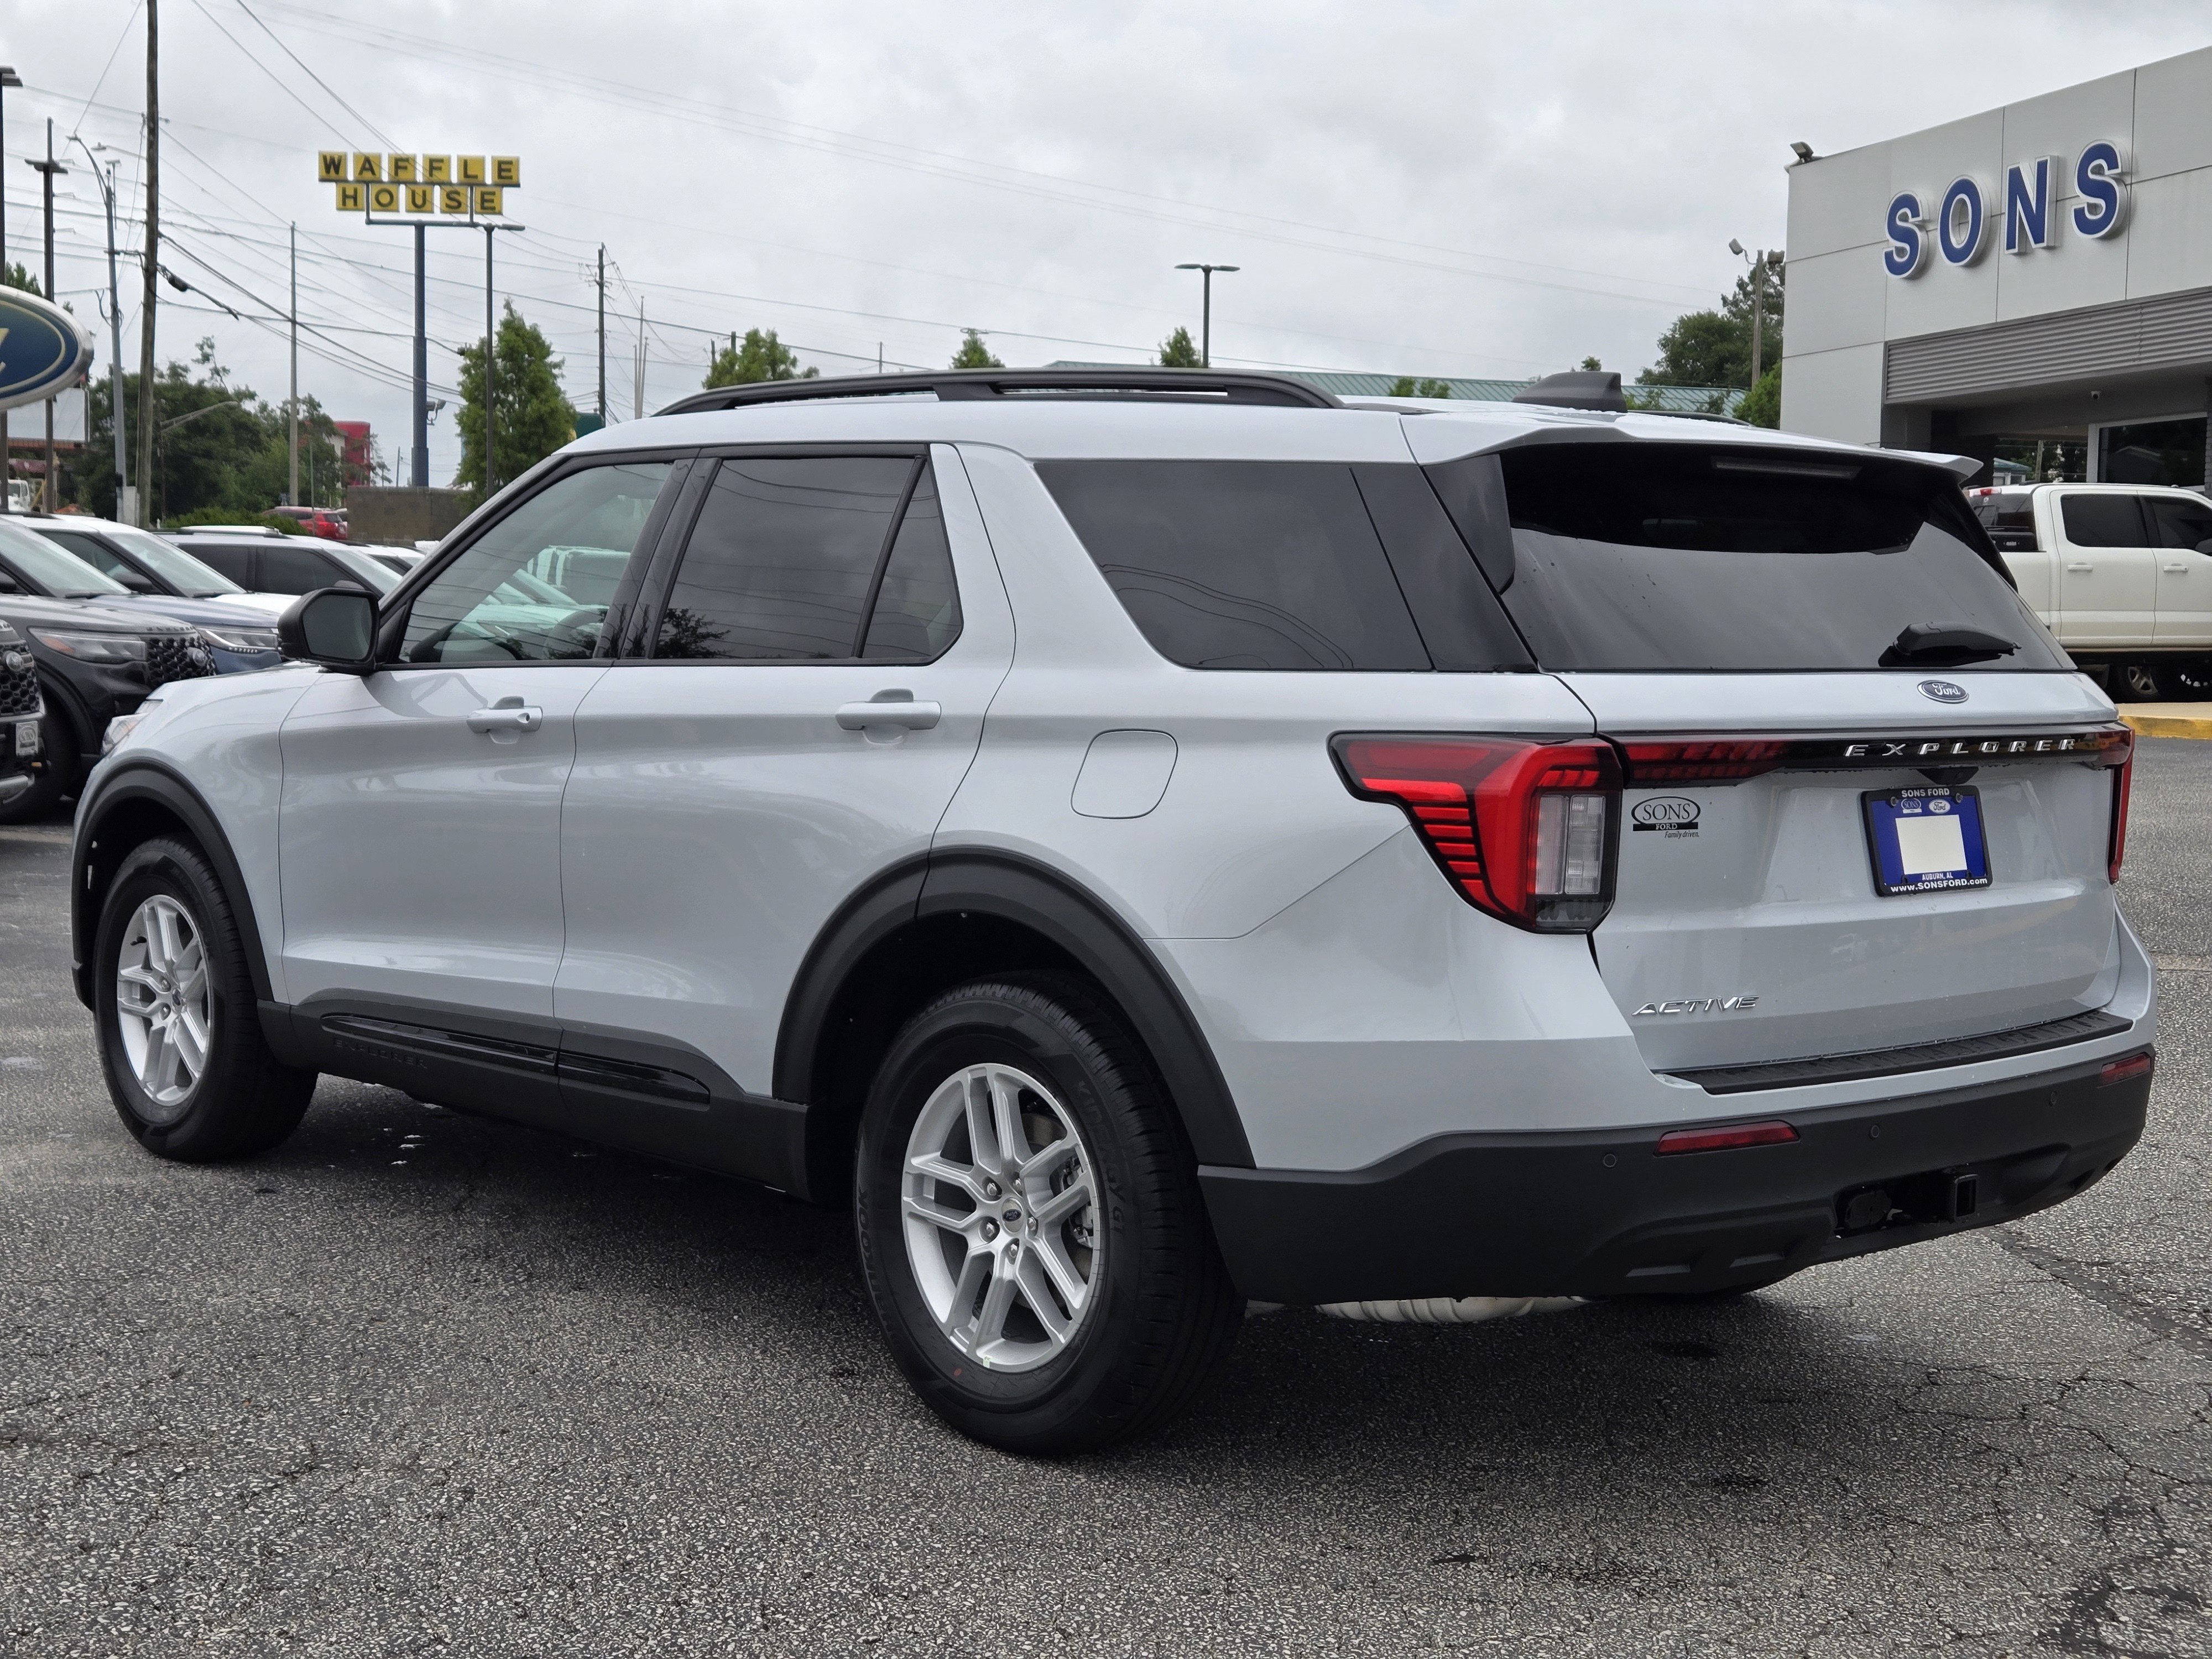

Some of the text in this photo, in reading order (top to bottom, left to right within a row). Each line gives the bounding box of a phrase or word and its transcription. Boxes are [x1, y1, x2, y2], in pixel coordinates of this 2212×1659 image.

[322, 155, 513, 180] WAFFLE
[342, 187, 496, 210] HOUSE
[1882, 139, 2125, 278] SONS
[1932, 682, 1960, 695] Ford
[1843, 738, 2075, 757] EXPLORER
[1902, 787, 1950, 797] SONS FORD
[1642, 803, 1691, 821] SONS
[1665, 831, 1682, 839] Family
[1890, 878, 1988, 893] www.SONSFORD.com
[1632, 994, 1759, 1016] ACTIVE
[333, 1037, 428, 1070] EXPLORER
